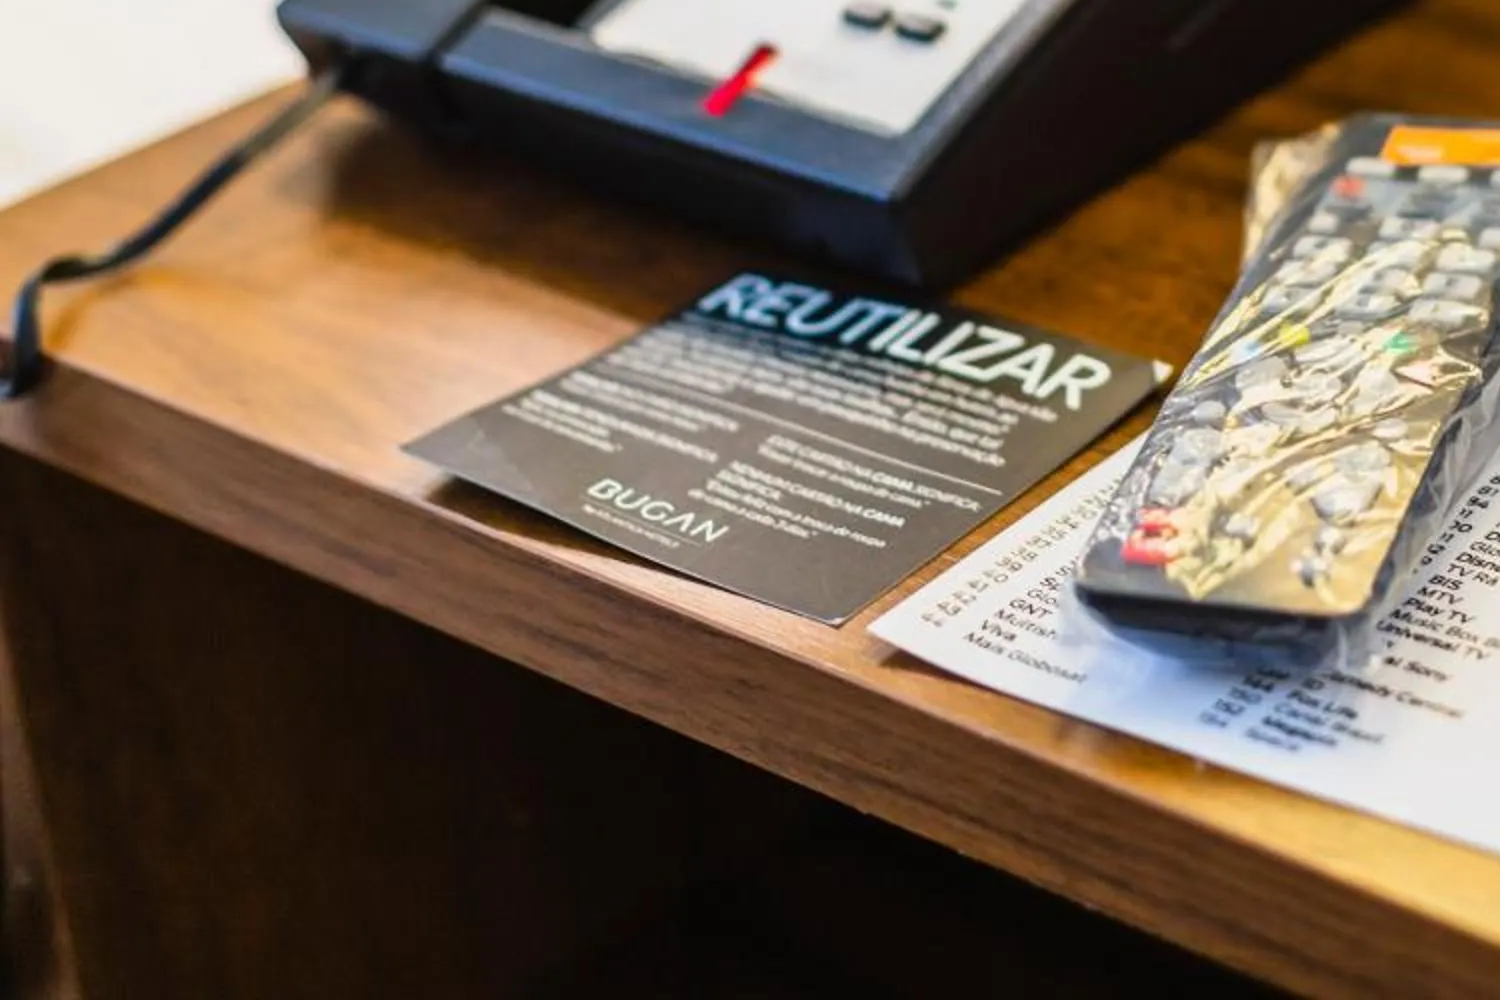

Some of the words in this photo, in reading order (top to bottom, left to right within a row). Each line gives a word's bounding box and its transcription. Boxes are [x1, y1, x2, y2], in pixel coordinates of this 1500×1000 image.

[696, 272, 1111, 410] REUTILIZAR
[586, 478, 730, 542] BUGAN
[1428, 574, 1464, 592] BIS
[1448, 563, 1475, 578] TV
[1009, 597, 1053, 619] GNT
[1416, 585, 1464, 606] MTV
[1402, 597, 1444, 617] Play
[1449, 609, 1475, 624] TV
[981, 619, 1018, 643] Viva
[1389, 608, 1444, 631] Music
[1445, 624, 1481, 643] Box
[962, 630, 1004, 656] Mais
[1376, 619, 1459, 652] Universal
[1464, 647, 1491, 661] TV
